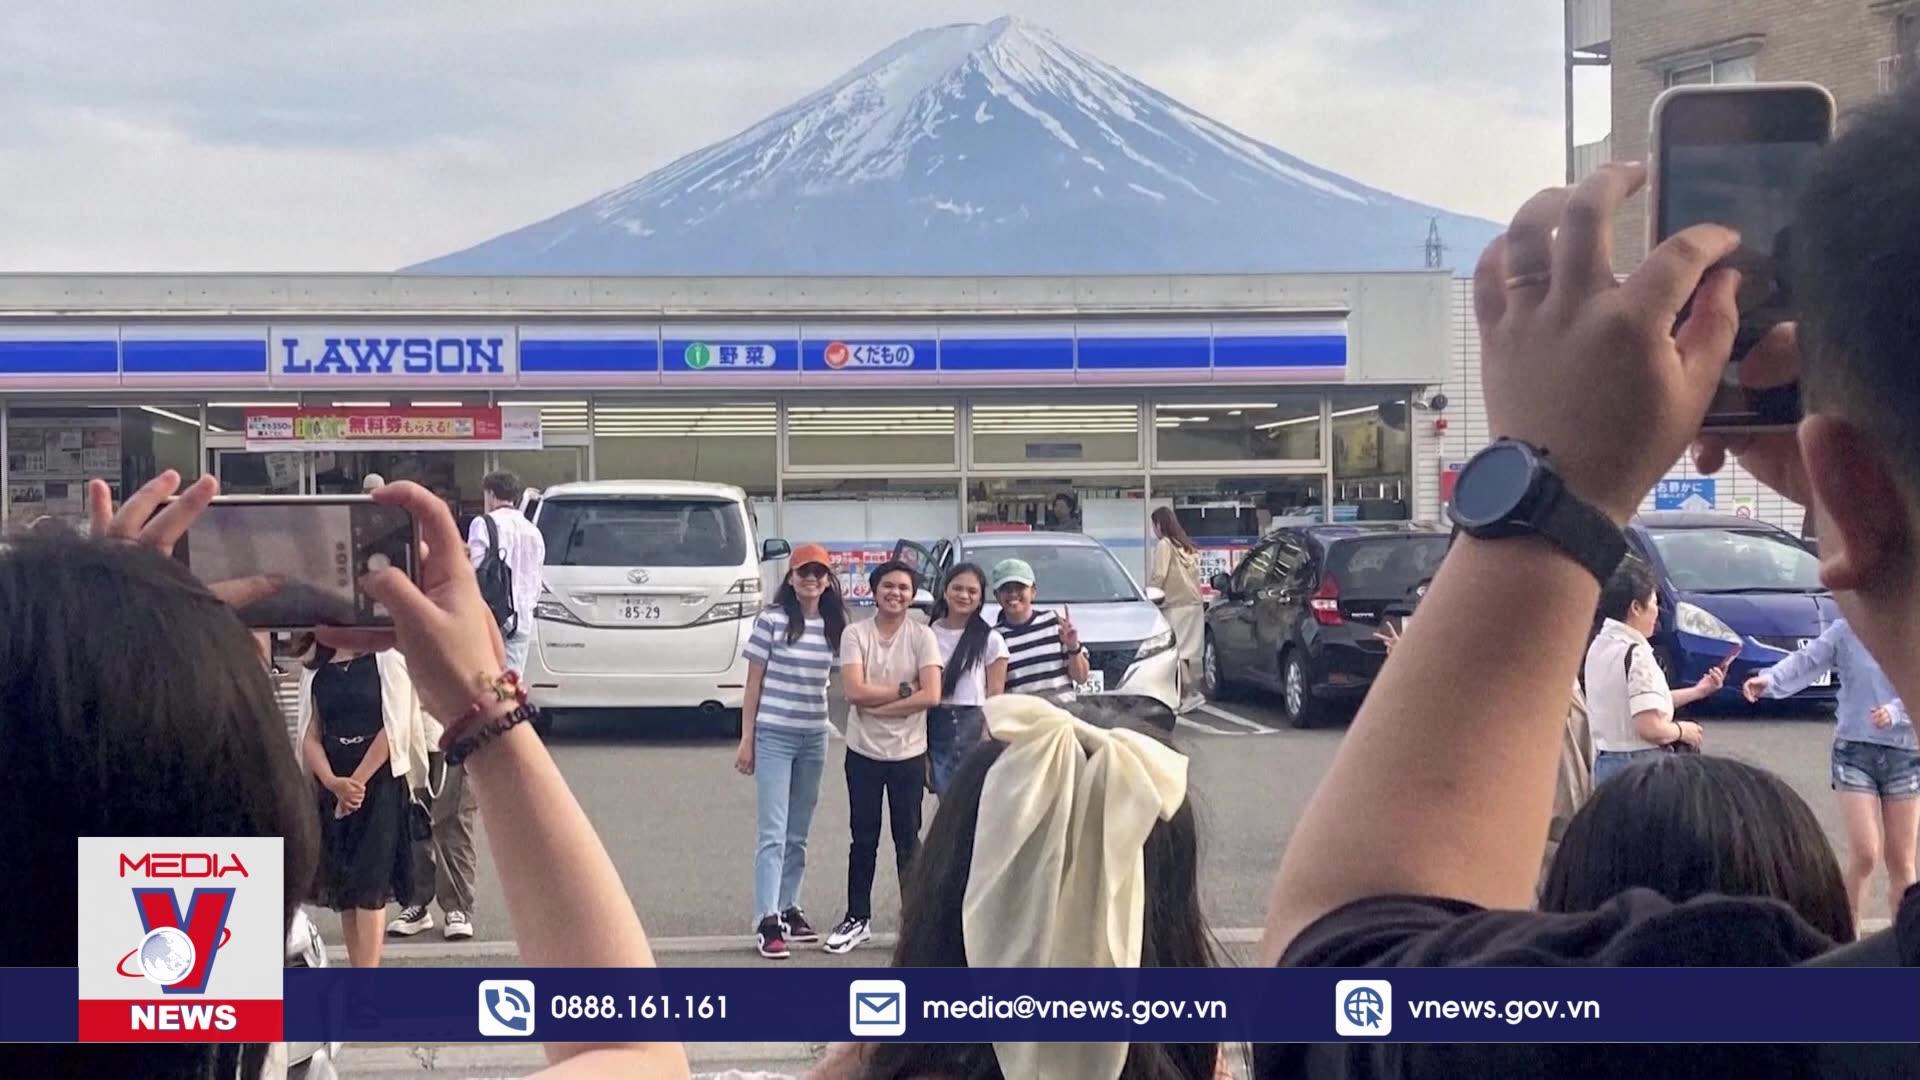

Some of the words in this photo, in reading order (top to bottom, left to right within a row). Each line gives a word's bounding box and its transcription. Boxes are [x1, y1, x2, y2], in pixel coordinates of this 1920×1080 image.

[282, 338, 504, 374] LAWSON
[719, 346, 764, 365] 野菜
[852, 346, 910, 364] くだもの
[625, 606, 660, 619] 85-29
